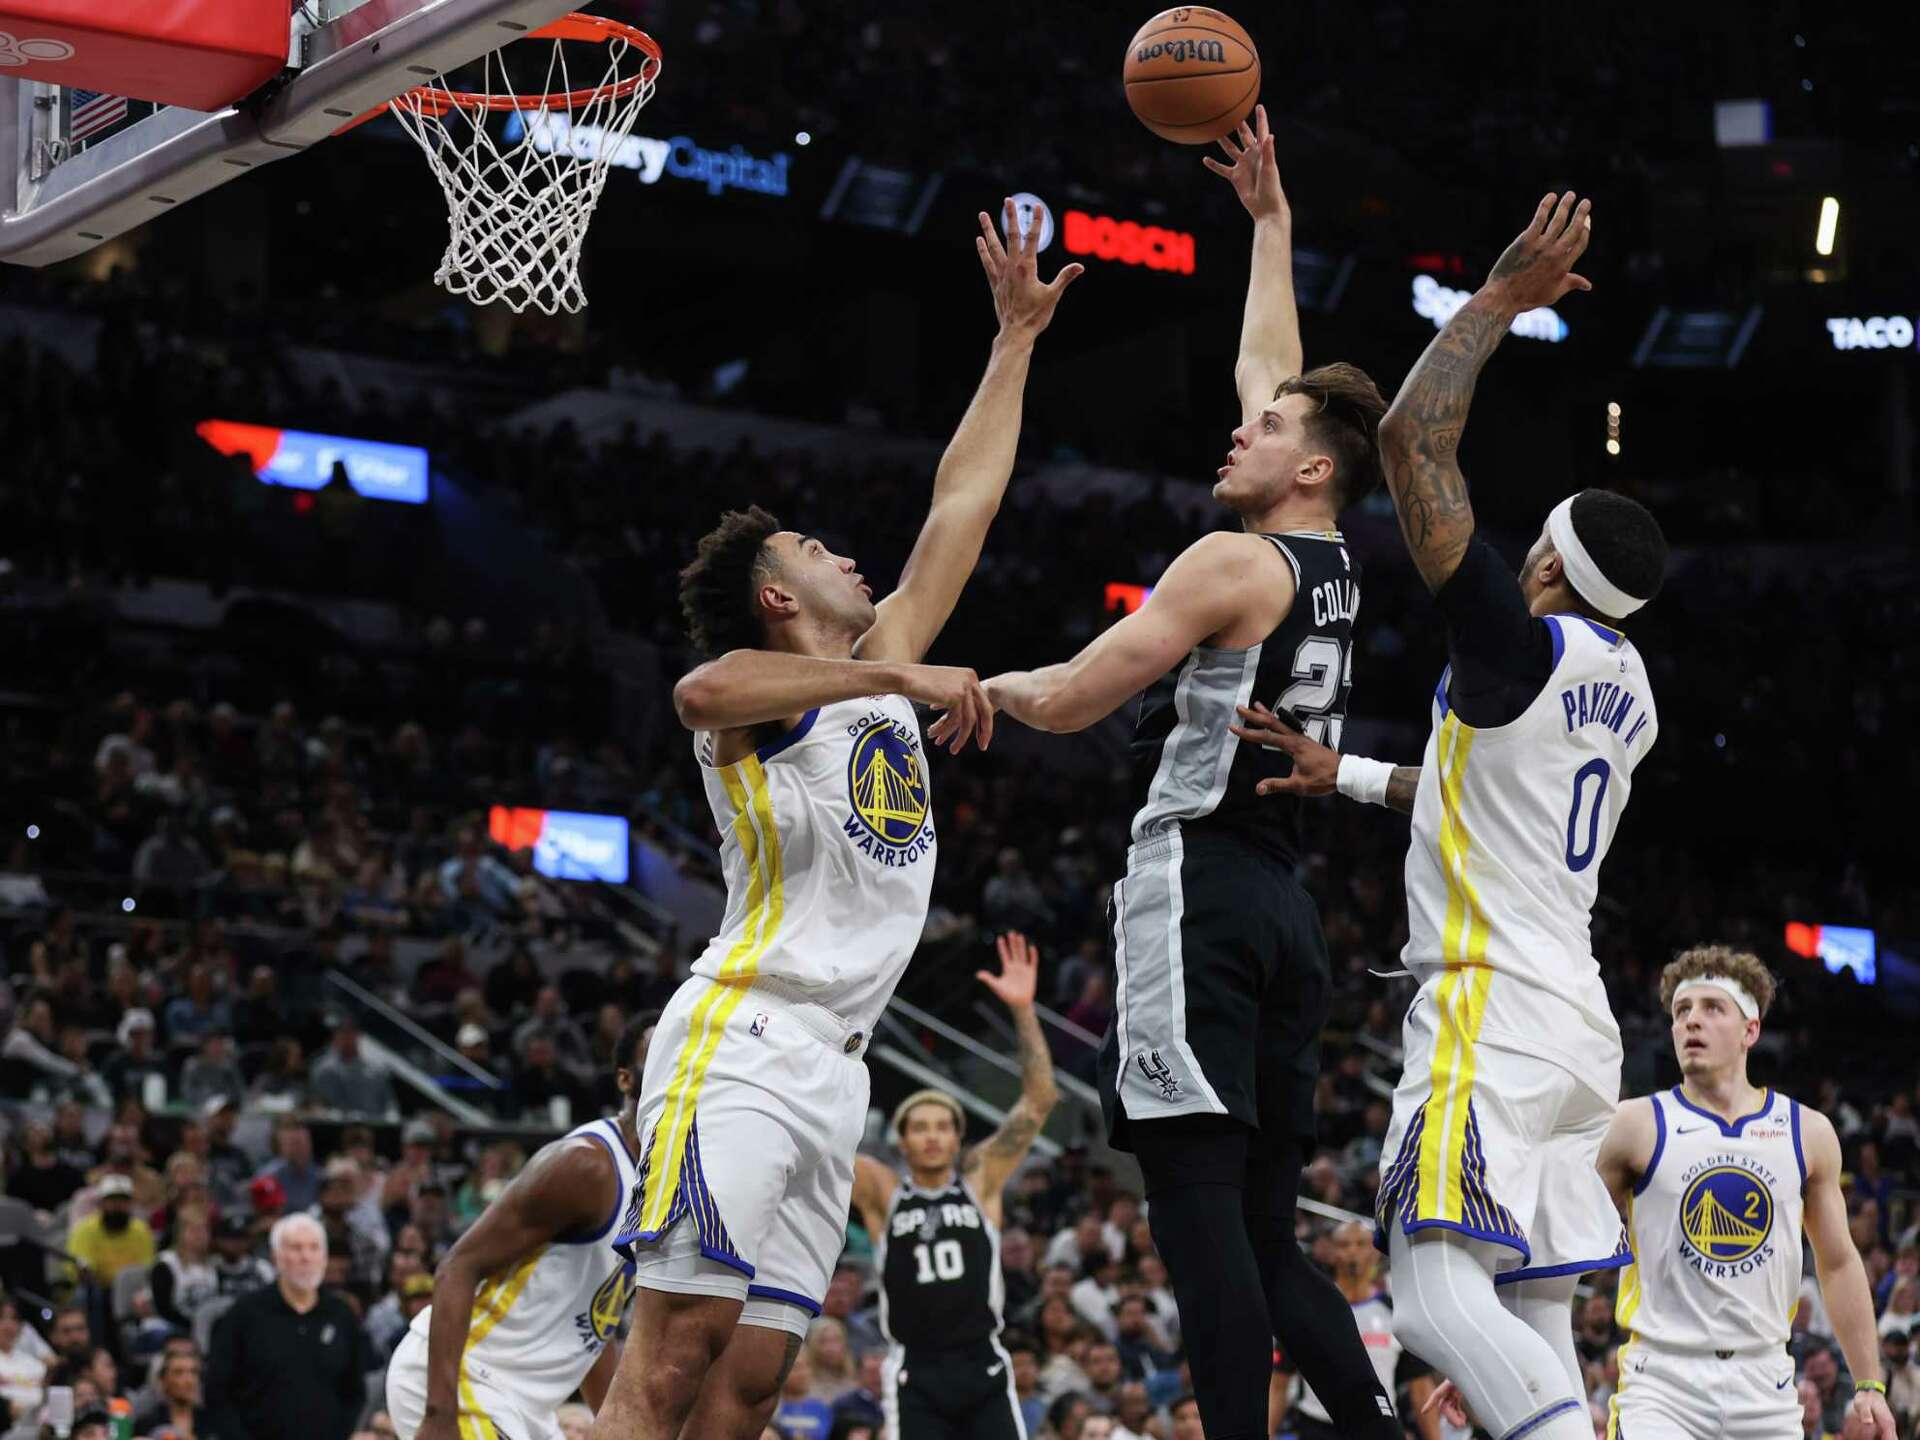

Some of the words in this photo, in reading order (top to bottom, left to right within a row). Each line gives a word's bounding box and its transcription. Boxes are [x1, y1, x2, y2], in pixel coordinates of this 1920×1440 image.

[1138, 40, 1225, 64] Wilson
[668, 136, 789, 197] Capital
[1064, 211, 1195, 274] BOSCH
[1826, 316, 1914, 350] TACO
[1561, 682, 1635, 734] PAYTON
[1566, 758, 1610, 873] 0
[843, 814, 935, 867] WARRIORS
[1682, 1154, 1735, 1183] GOLDEN
[1741, 1157, 1778, 1187] STATE
[1744, 1192, 1760, 1219] 2
[913, 1239, 965, 1284] 10
[1679, 1240, 1774, 1278] WARRIORS
